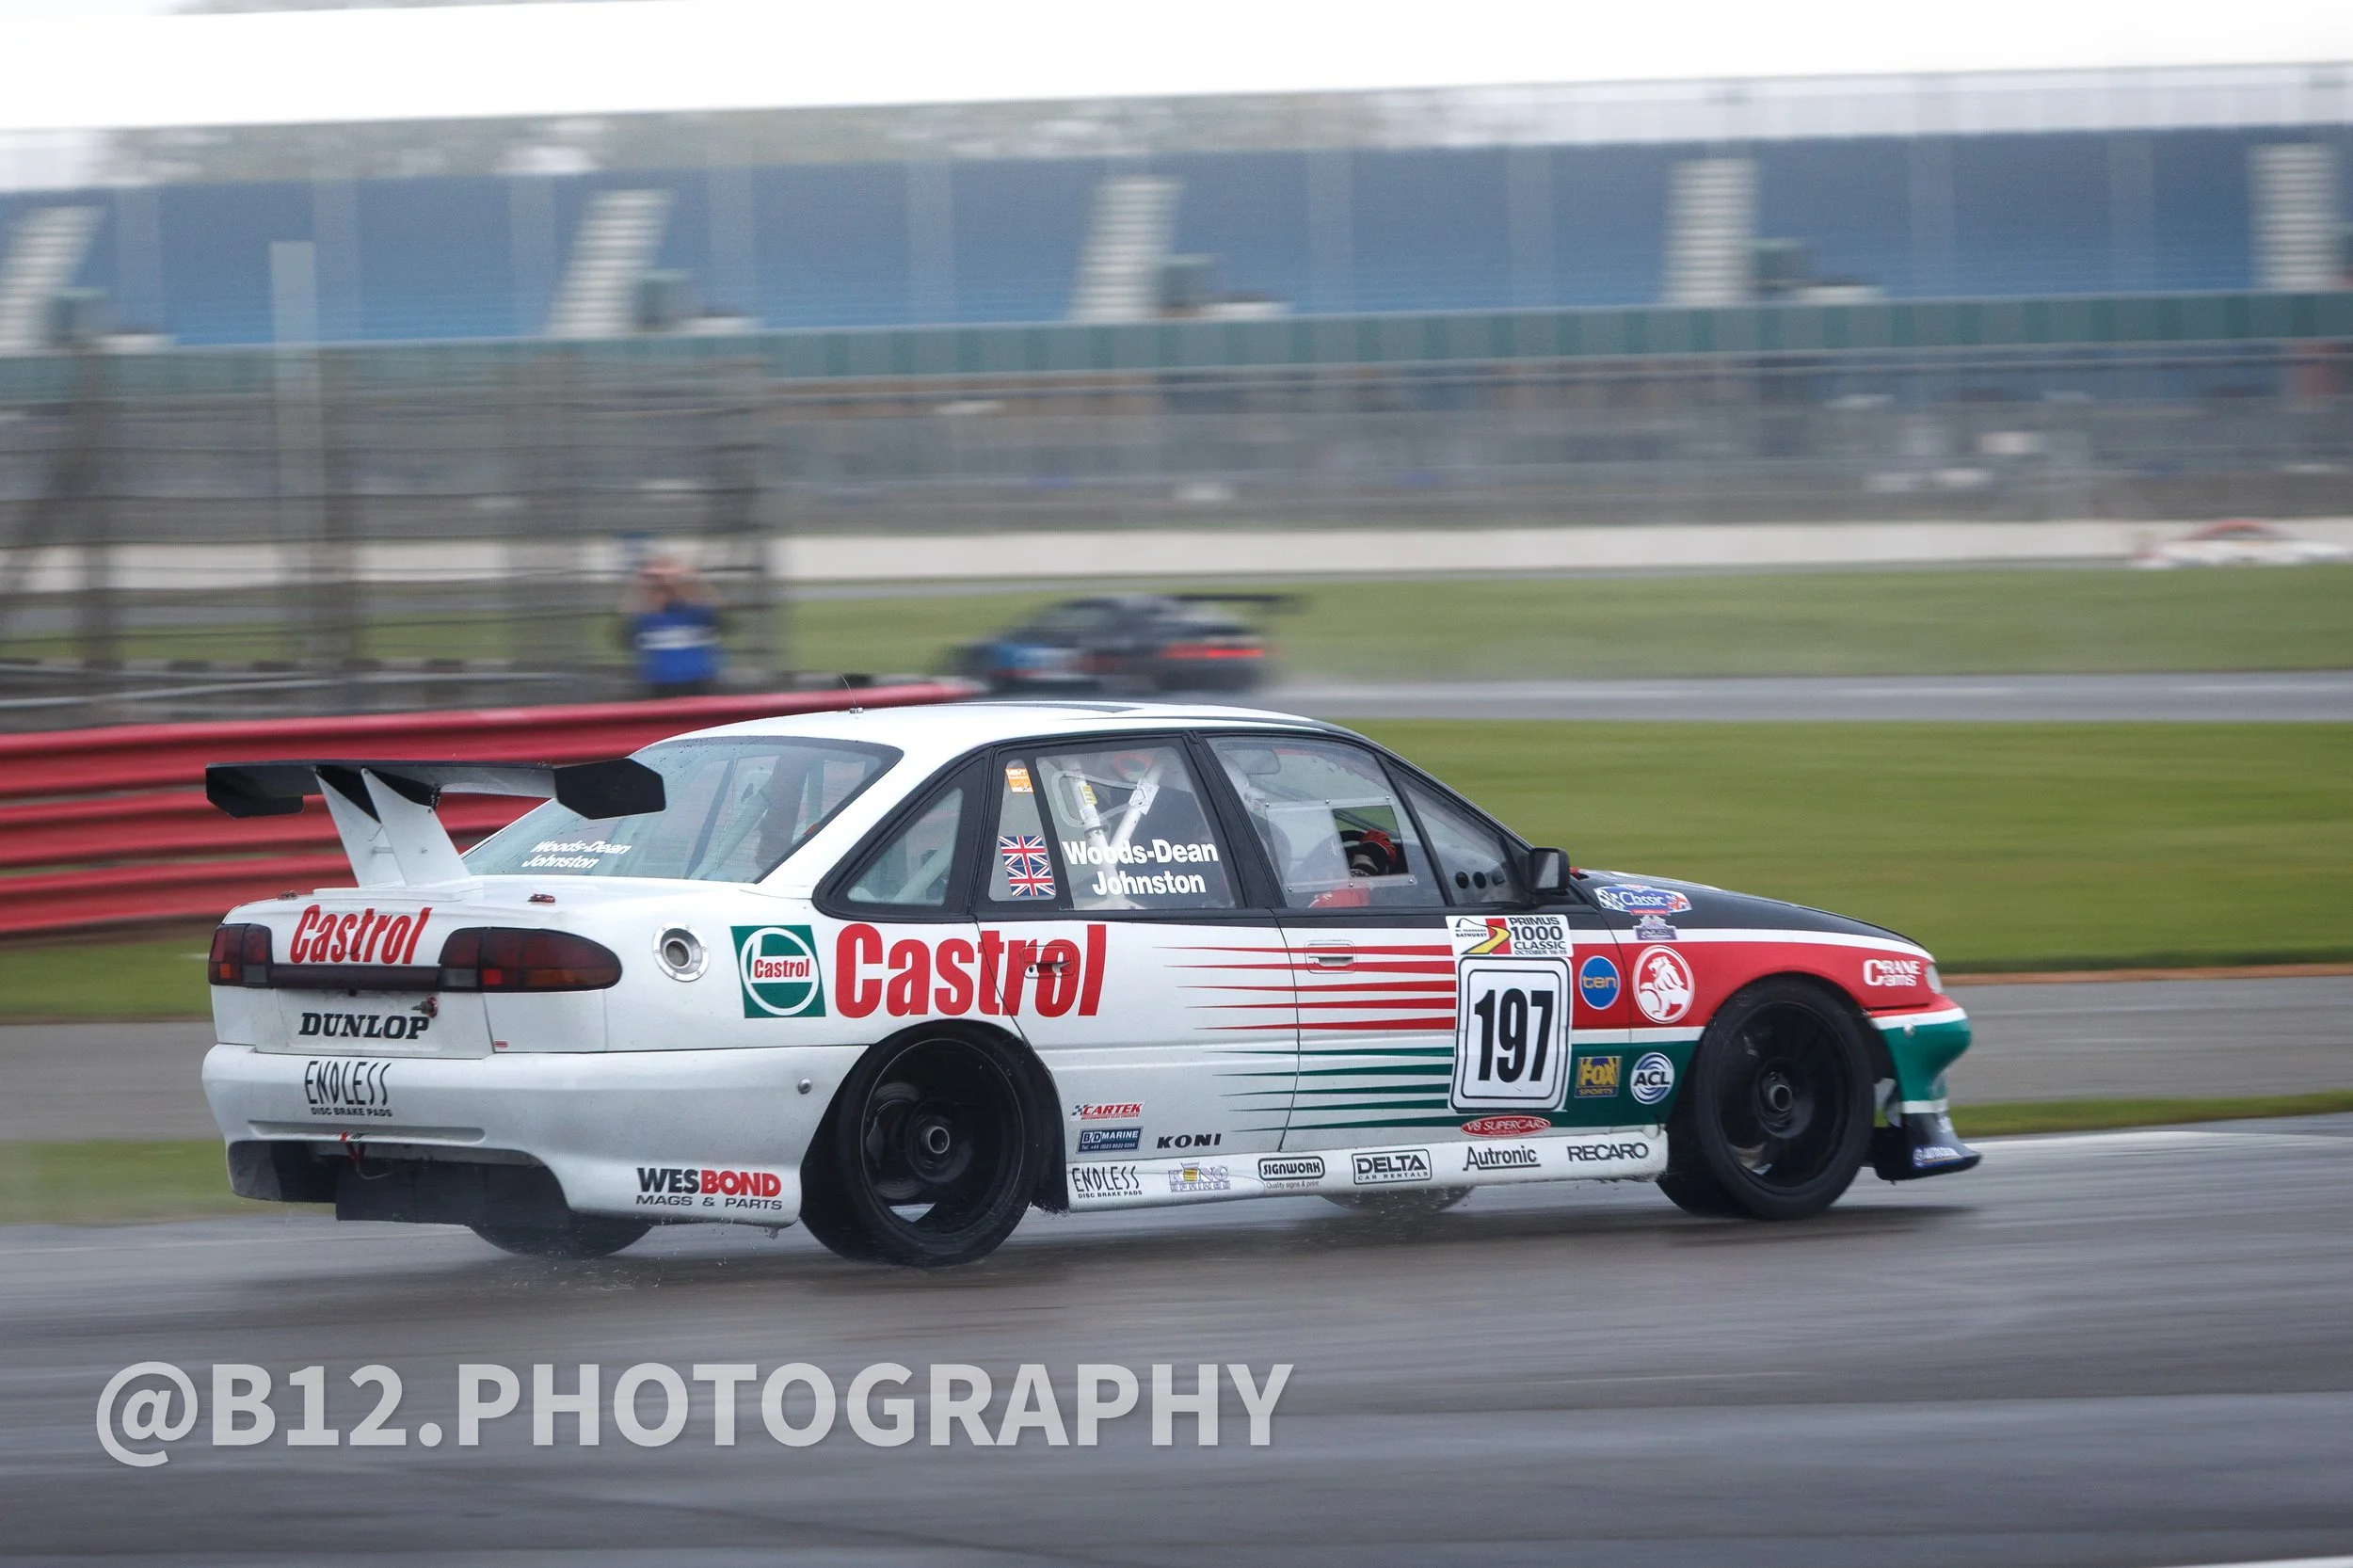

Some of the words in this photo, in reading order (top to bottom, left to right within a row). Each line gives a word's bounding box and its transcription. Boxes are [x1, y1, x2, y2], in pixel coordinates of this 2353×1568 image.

[530, 840, 632, 854] Woods-Dean
[1062, 840, 1219, 865] Woods-Dean
[521, 855, 600, 868] Johnston
[1092, 871, 1207, 895] Johnston
[1619, 891, 1667, 905] Classic
[1508, 917, 1560, 925] PRIMUS
[290, 904, 433, 964] Castrol
[1511, 926, 1562, 940] 1000
[1514, 941, 1566, 950] CLASSIC
[754, 959, 810, 978] Castrol
[836, 922, 1106, 1018] Castrol
[1581, 976, 1617, 988] ten
[298, 1013, 429, 1039] DUNLOP
[1474, 988, 1554, 1082] 197
[1580, 1058, 1620, 1085] FOX
[1634, 1071, 1670, 1086] ACL
[305, 1061, 392, 1106] ENDLESS
[1578, 1087, 1613, 1096] SPORTS
[1083, 1103, 1142, 1115] CARTEK
[1483, 1119, 1546, 1131] SUPERCARS
[1102, 1130, 1139, 1140] MARINE
[1157, 1134, 1222, 1149] KONI
[1463, 1145, 1541, 1171] Autronic
[1566, 1143, 1649, 1161] RECARO
[1356, 1155, 1427, 1175] DELTA
[637, 1168, 781, 1197] WESBOND
[1072, 1166, 1140, 1192] ENDLESS
[635, 1195, 693, 1207] MAGS
[702, 1196, 715, 1207] &
[725, 1198, 783, 1210] PARTS
